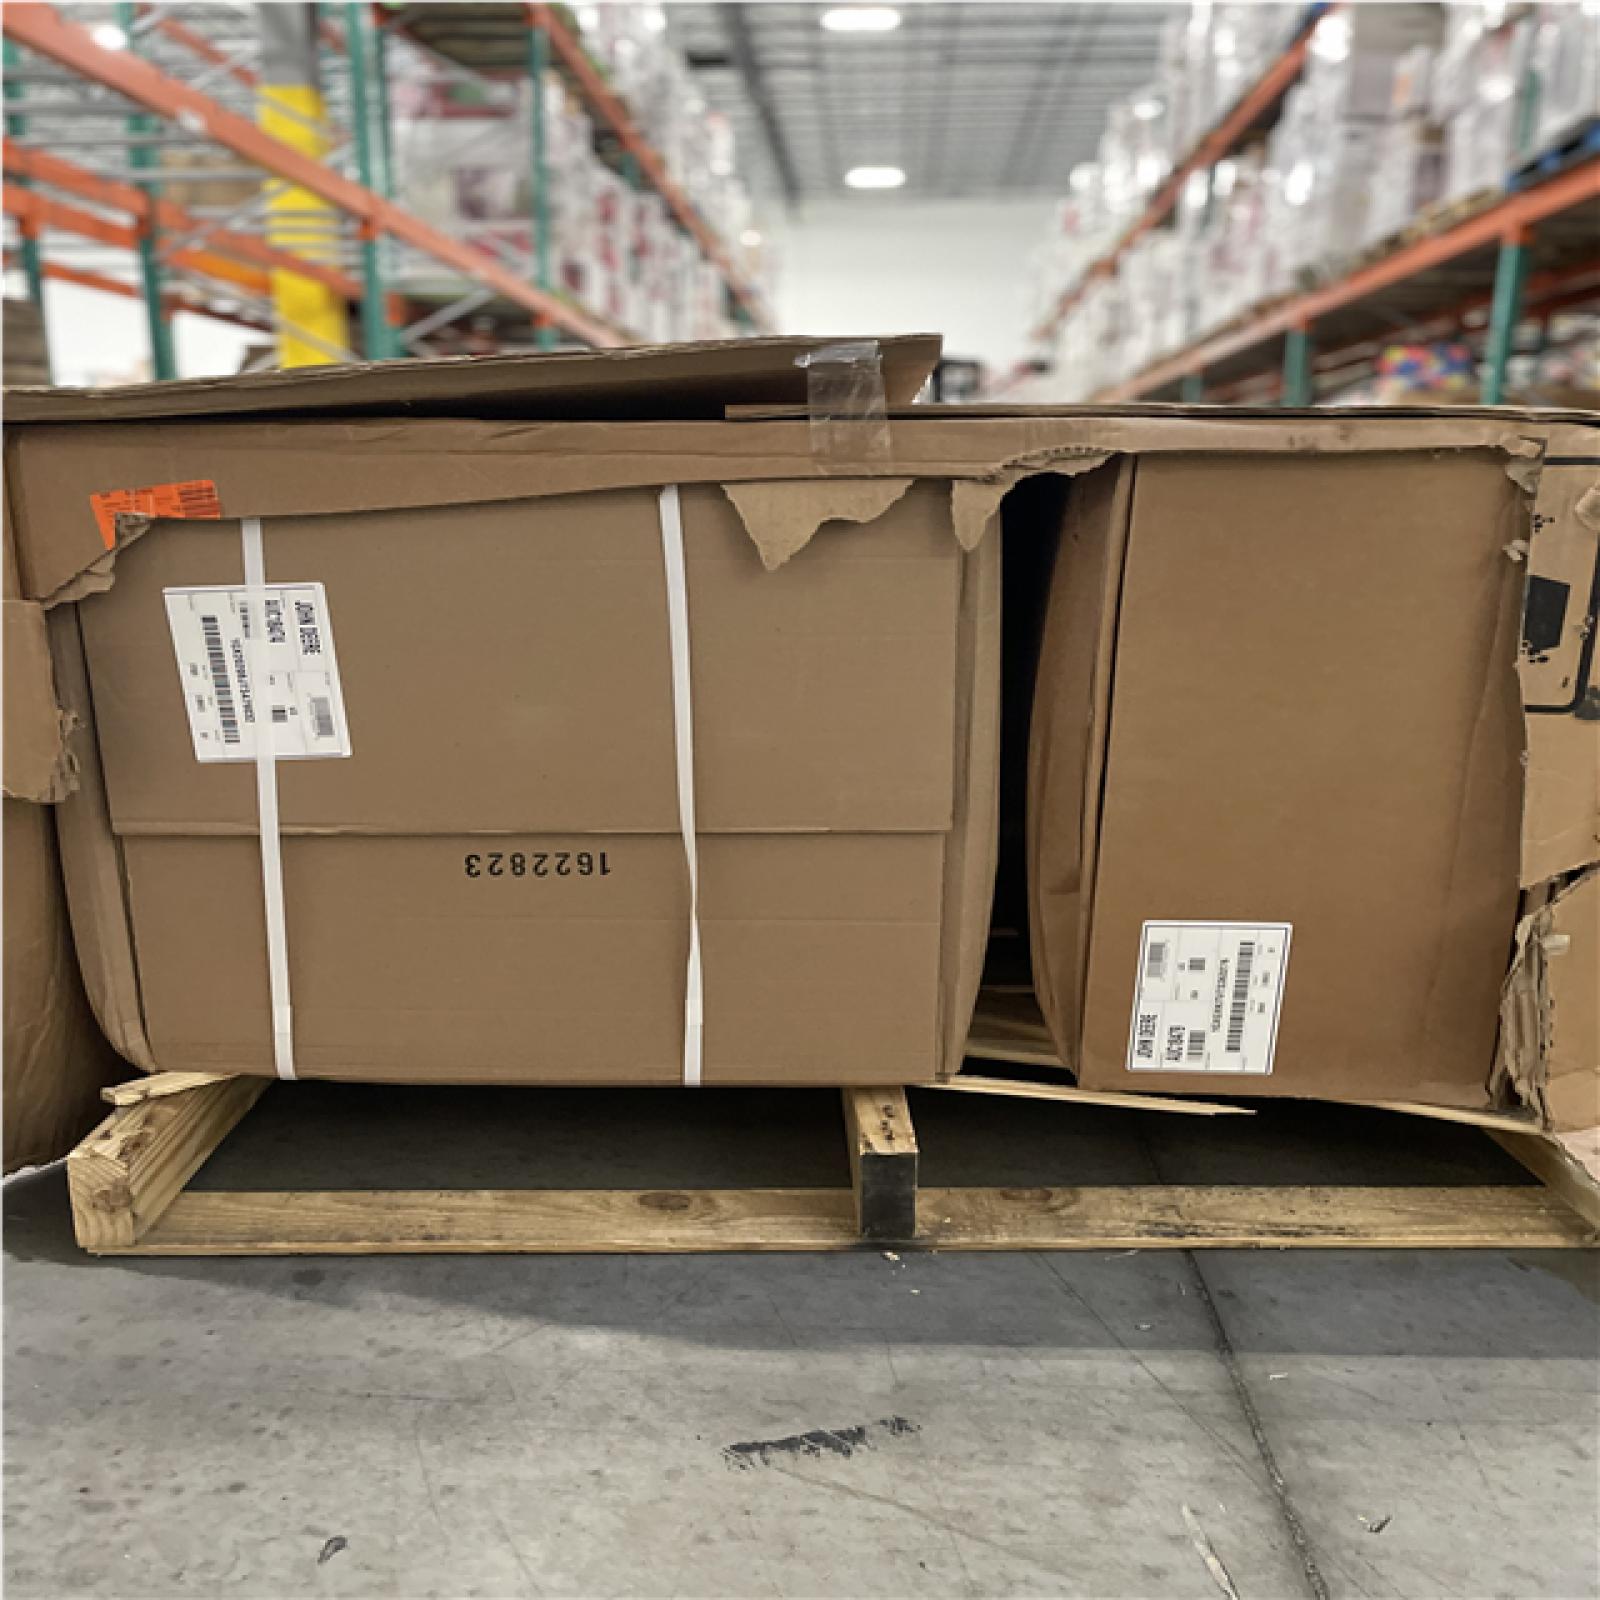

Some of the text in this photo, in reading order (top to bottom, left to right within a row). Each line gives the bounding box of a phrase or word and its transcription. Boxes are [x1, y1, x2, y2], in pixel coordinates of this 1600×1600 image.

[295, 601, 320, 655] JOHN DEERE
[465, 852, 610, 877] 1622823
[1137, 1015, 1157, 1058] JOHN DEERE
